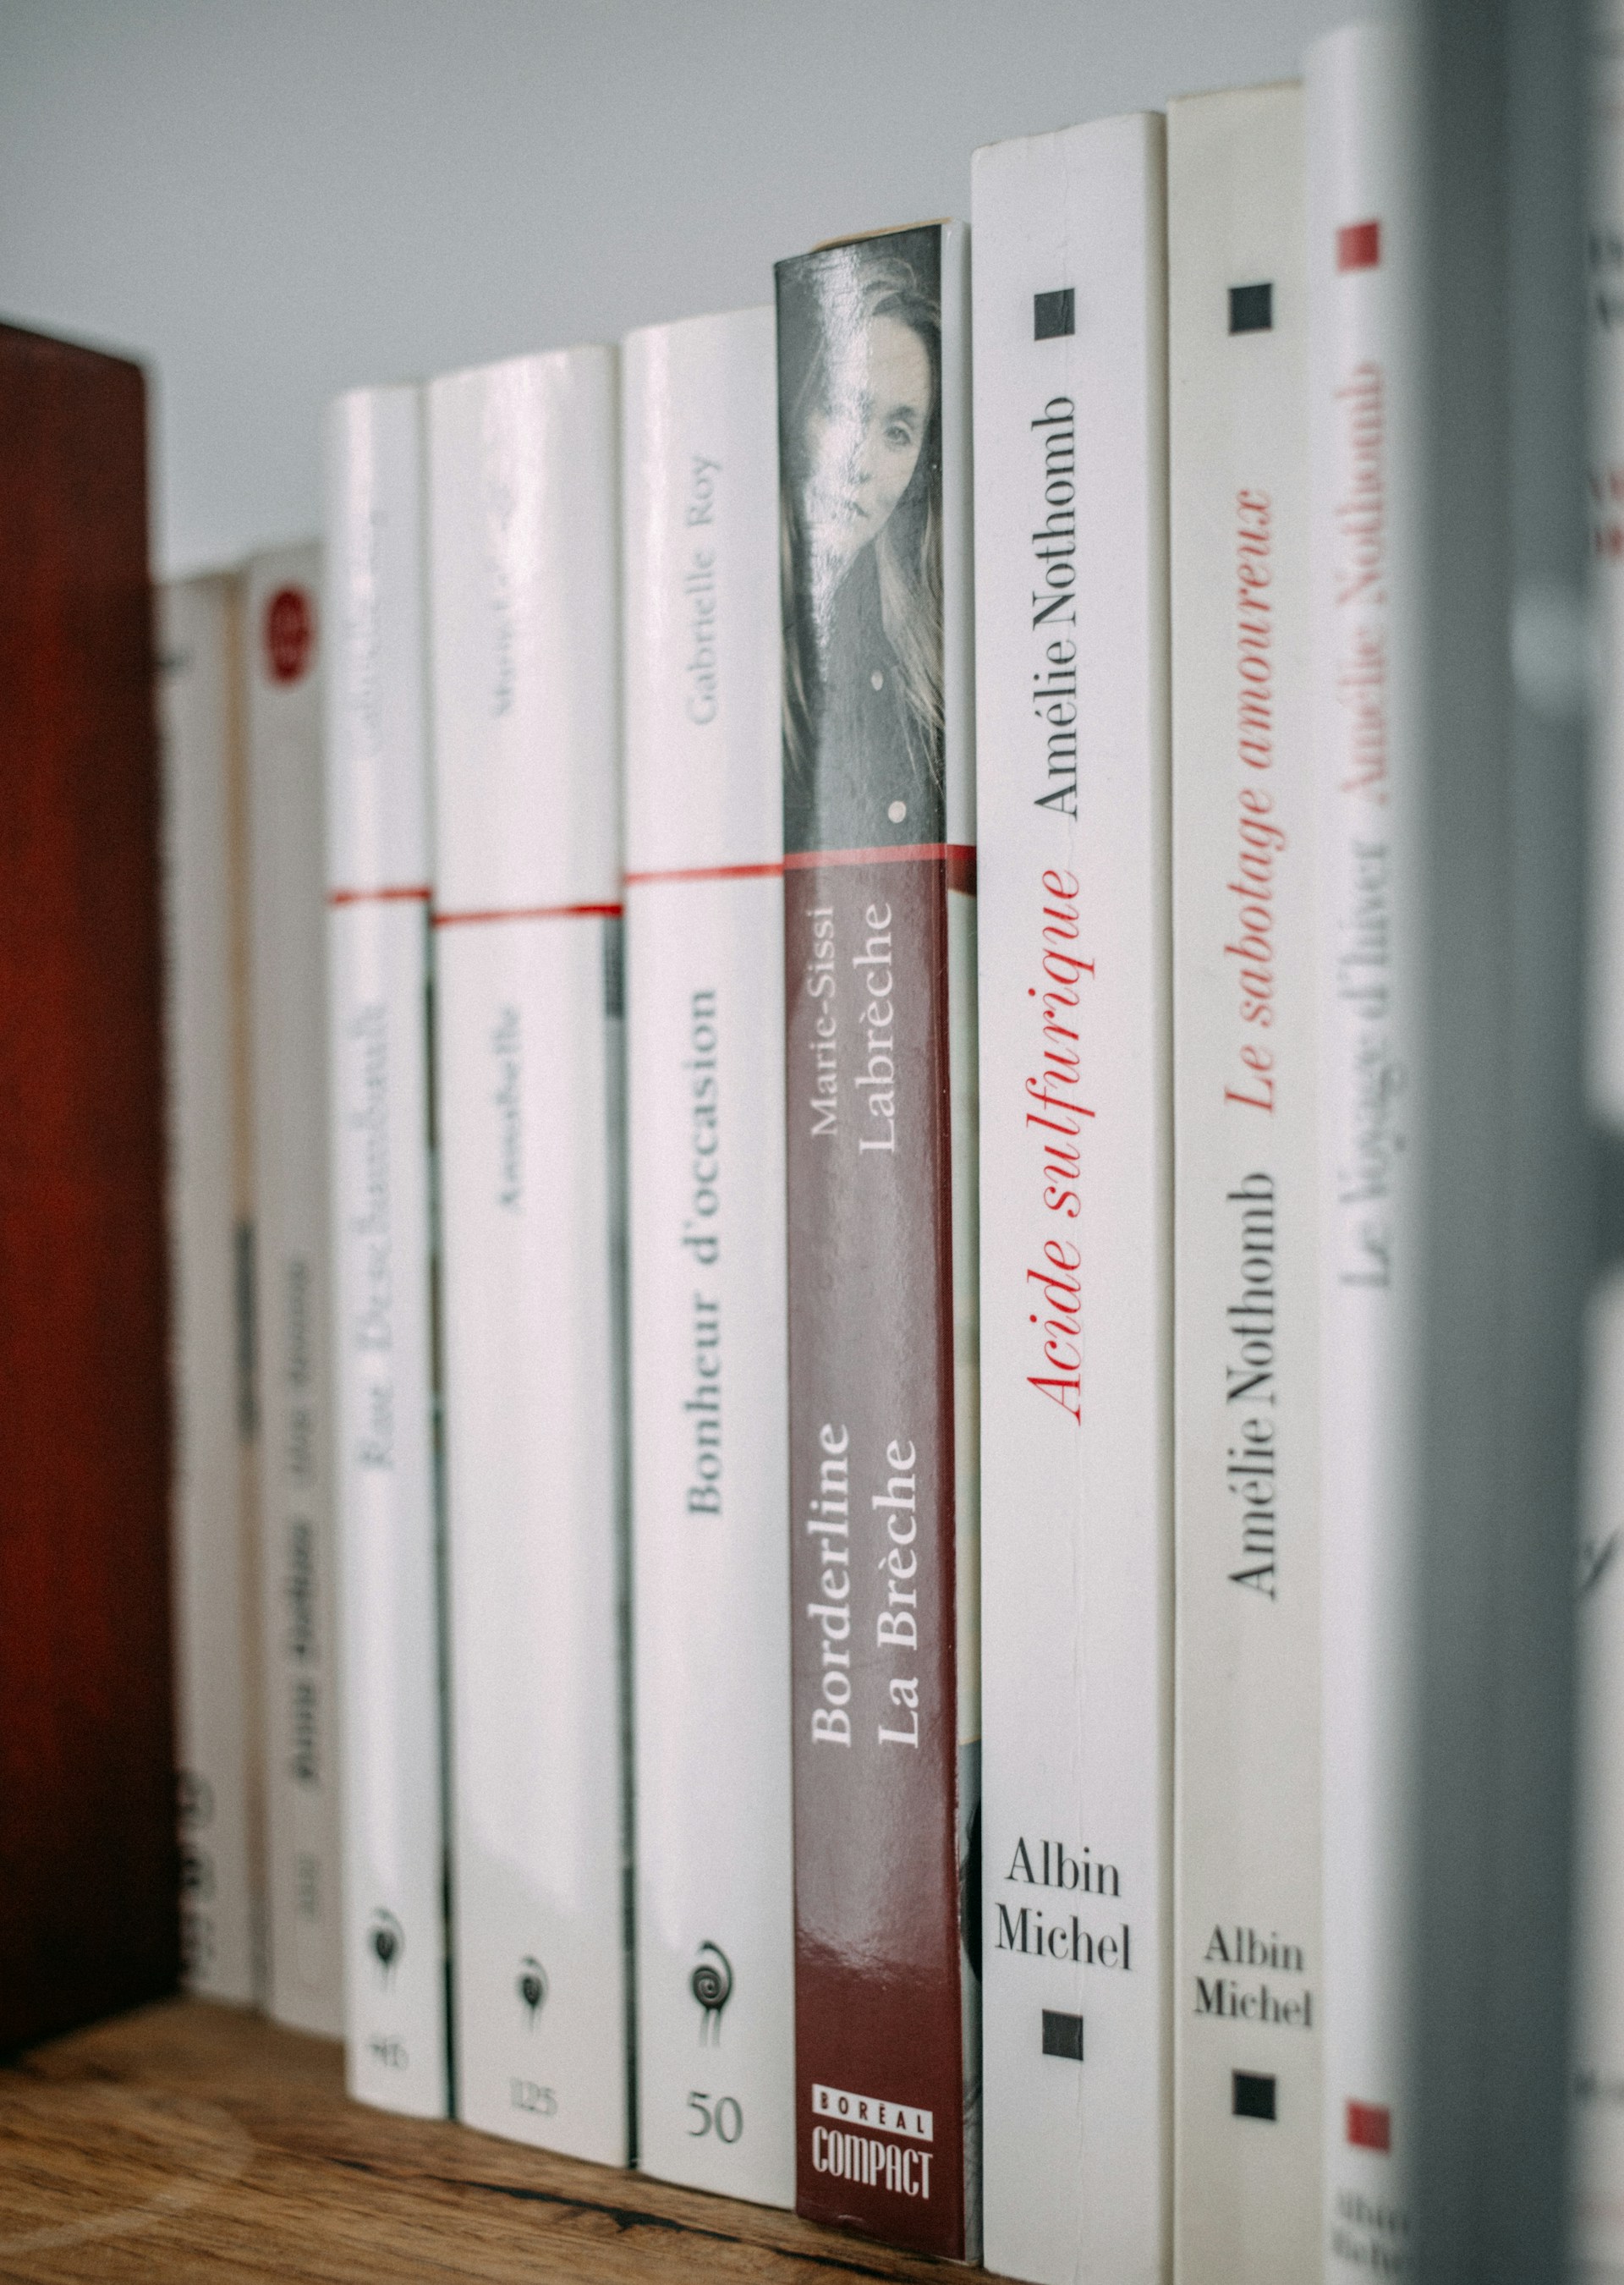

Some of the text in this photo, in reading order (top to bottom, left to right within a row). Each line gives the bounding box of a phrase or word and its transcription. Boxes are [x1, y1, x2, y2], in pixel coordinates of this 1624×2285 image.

[685, 455, 723, 726] Gabrielle Roy
[1030, 395, 1078, 821] Amélie Nothomb
[1333, 360, 1384, 606] Nothomb
[1223, 488, 1287, 1115] Le sabotage amoureux
[806, 904, 838, 1137] Marie-Sissi
[852, 902, 896, 1154] Labrèche
[1024, 868, 1096, 1425] Acide sulfurique
[681, 989, 721, 1516] Bonheur d'occasion
[1226, 1172, 1277, 1601] Amélie Nothomb
[805, 1422, 852, 1748] Borderline
[870, 1438, 919, 1748] La Brèche
[995, 1902, 1133, 1972] Michel
[1005, 1836, 1121, 1898] Albin
[1204, 1923, 1304, 1972] Albin
[687, 2090, 744, 2145] 50
[1193, 1975, 1315, 2028] Michel
[812, 2124, 933, 2200] COMPACT
